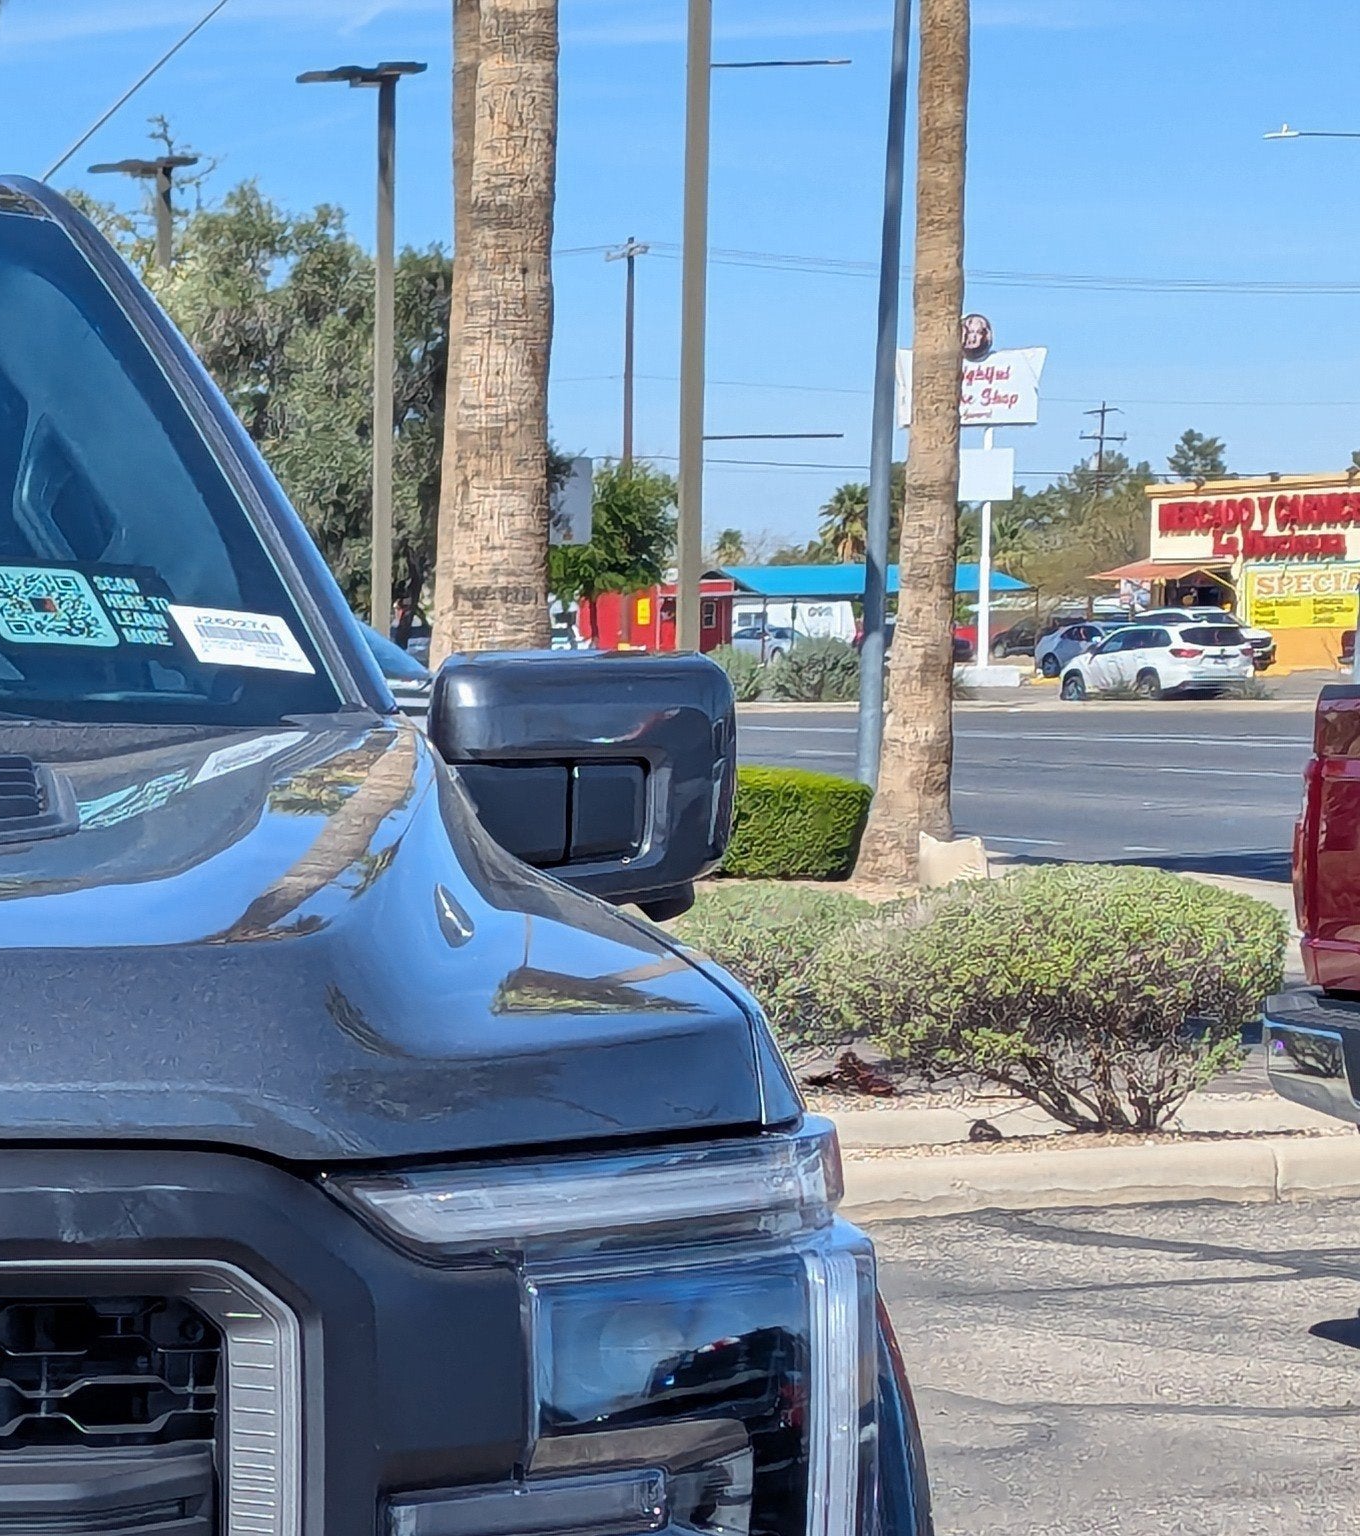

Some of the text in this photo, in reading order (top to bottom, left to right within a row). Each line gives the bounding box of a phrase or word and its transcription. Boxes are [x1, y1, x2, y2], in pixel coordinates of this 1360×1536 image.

[93, 576, 140, 593] SCAN
[102, 593, 149, 611] HERE
[112, 610, 170, 629] LEARN
[121, 627, 173, 646] MORE
